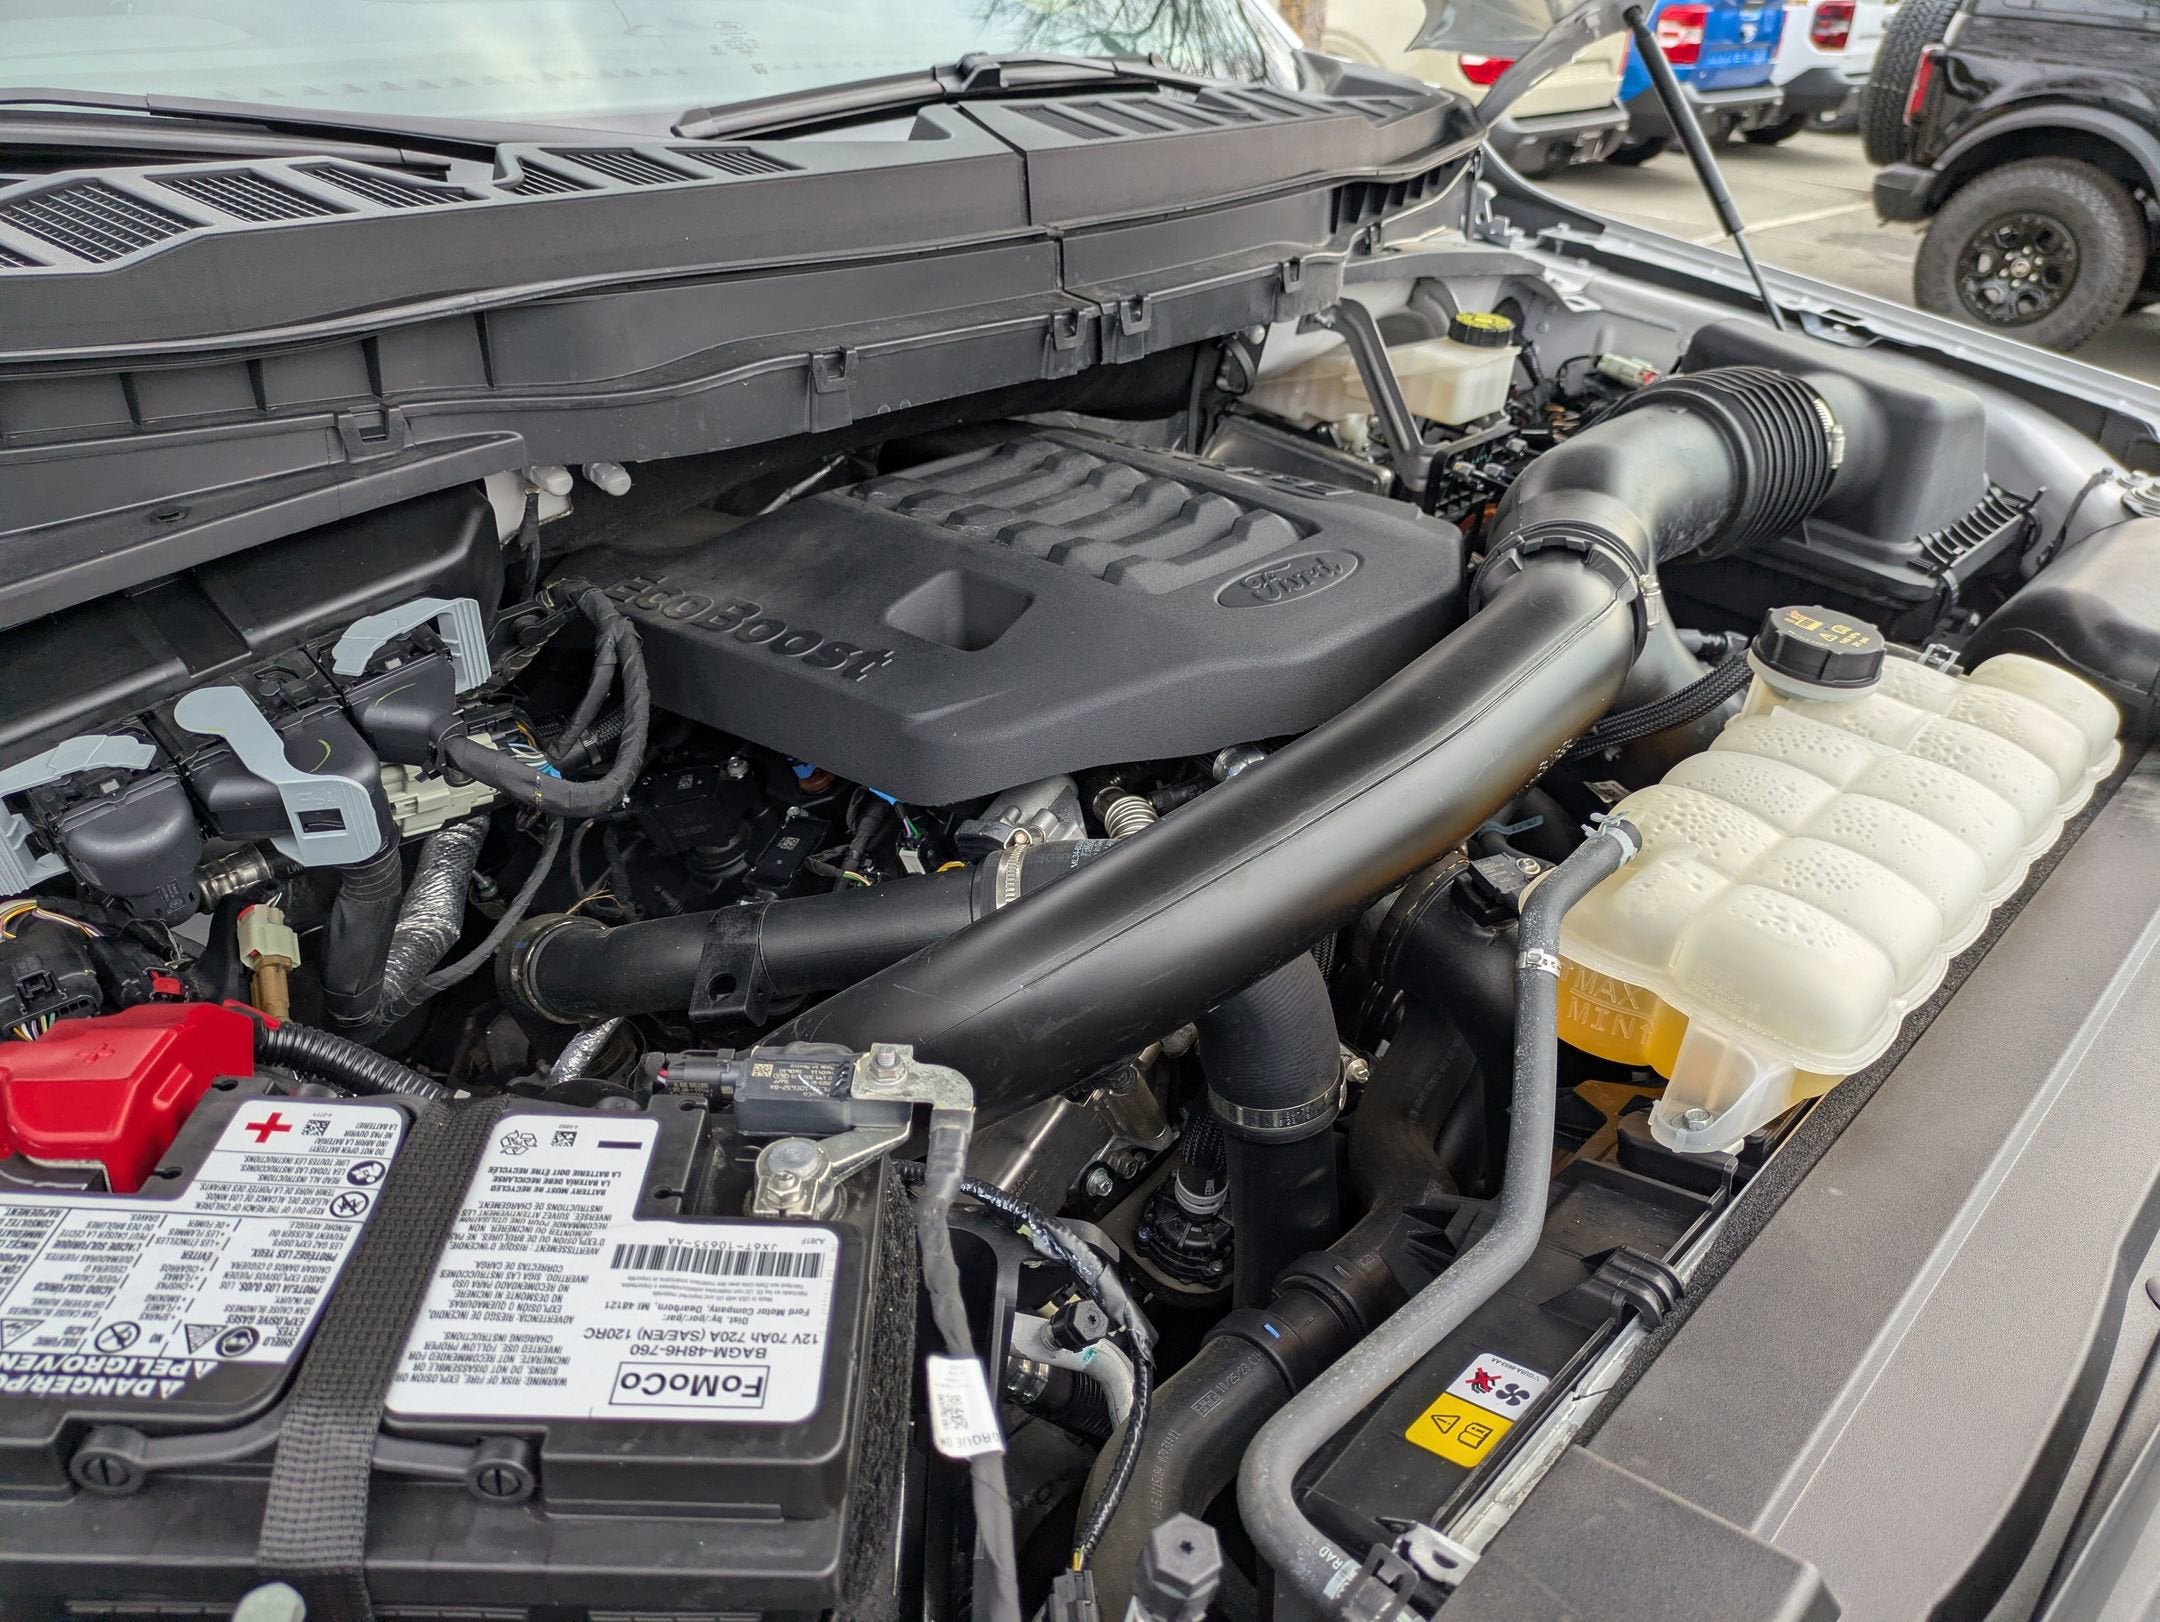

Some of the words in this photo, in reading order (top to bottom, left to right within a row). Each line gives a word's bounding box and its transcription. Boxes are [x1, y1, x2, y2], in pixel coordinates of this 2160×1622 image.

[1240, 556, 1343, 600] Ford
[1573, 966, 1640, 1010] MAX
[1567, 996, 1637, 1040] MIN
[668, 1238, 777, 1251] JX6T-10655-AA
[605, 1301, 635, 1310] 48121
[637, 1302, 651, 1311] MI
[654, 1302, 703, 1314] Dearborn,
[706, 1304, 754, 1315] Company,
[757, 1307, 786, 1316] Motor
[788, 1308, 810, 1317] Ford
[727, 1316, 749, 1326] Dist.
[583, 1327, 631, 1340] 120RC
[637, 1326, 706, 1342] (SAE/EN)
[710, 1331, 745, 1343] 720A
[750, 1332, 788, 1344] 70Ah
[792, 1333, 818, 1345] 12V
[630, 1344, 767, 1360] BAGM-48H6-760
[523, 1376, 567, 1387] WARNING:
[620, 1372, 763, 1398] FoMoCo
[1319, 1545, 1344, 1570] RAD
